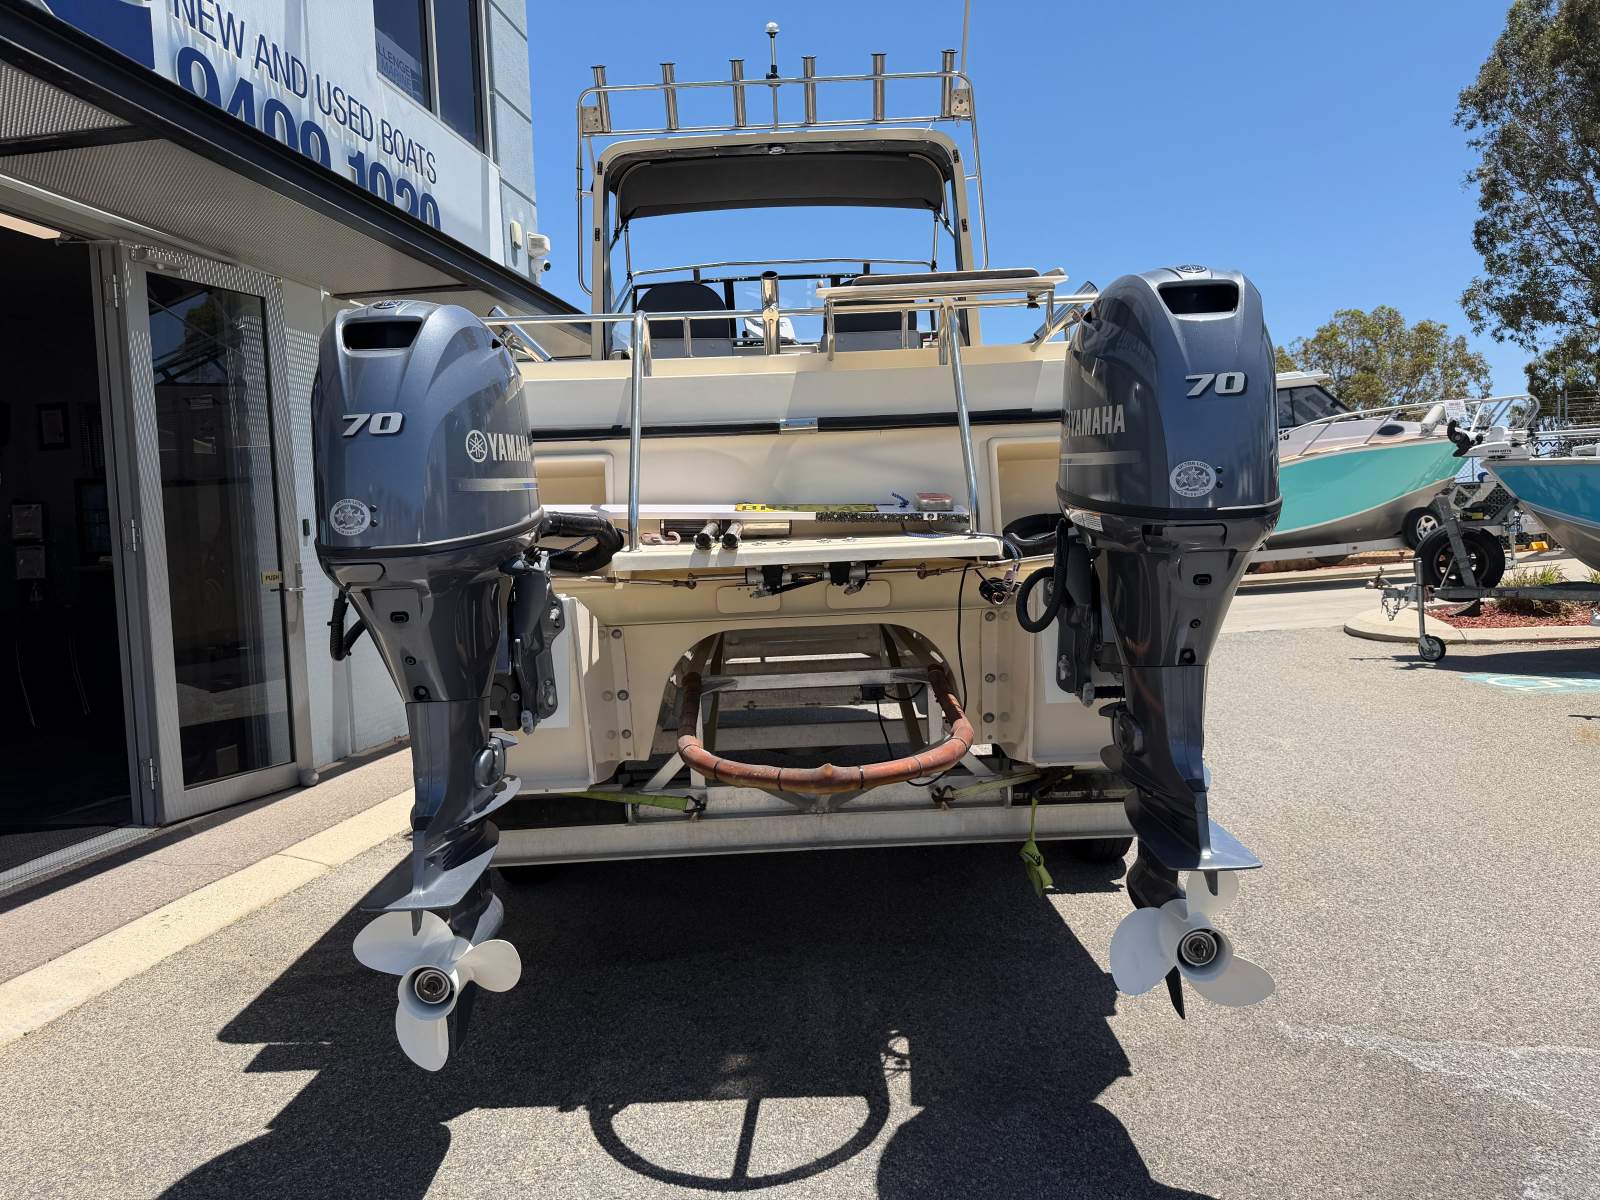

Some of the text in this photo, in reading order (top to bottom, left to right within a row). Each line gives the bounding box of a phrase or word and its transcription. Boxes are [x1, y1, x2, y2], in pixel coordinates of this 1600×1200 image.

[174, 0, 245, 59] NEW
[254, 33, 307, 99] AND
[316, 74, 374, 142] USED
[381, 118, 437, 184] BOATS
[1184, 371, 1246, 397] 70
[342, 411, 403, 437] 70
[1070, 404, 1126, 437] YAMAHA
[486, 432, 532, 462] YAMAHA
